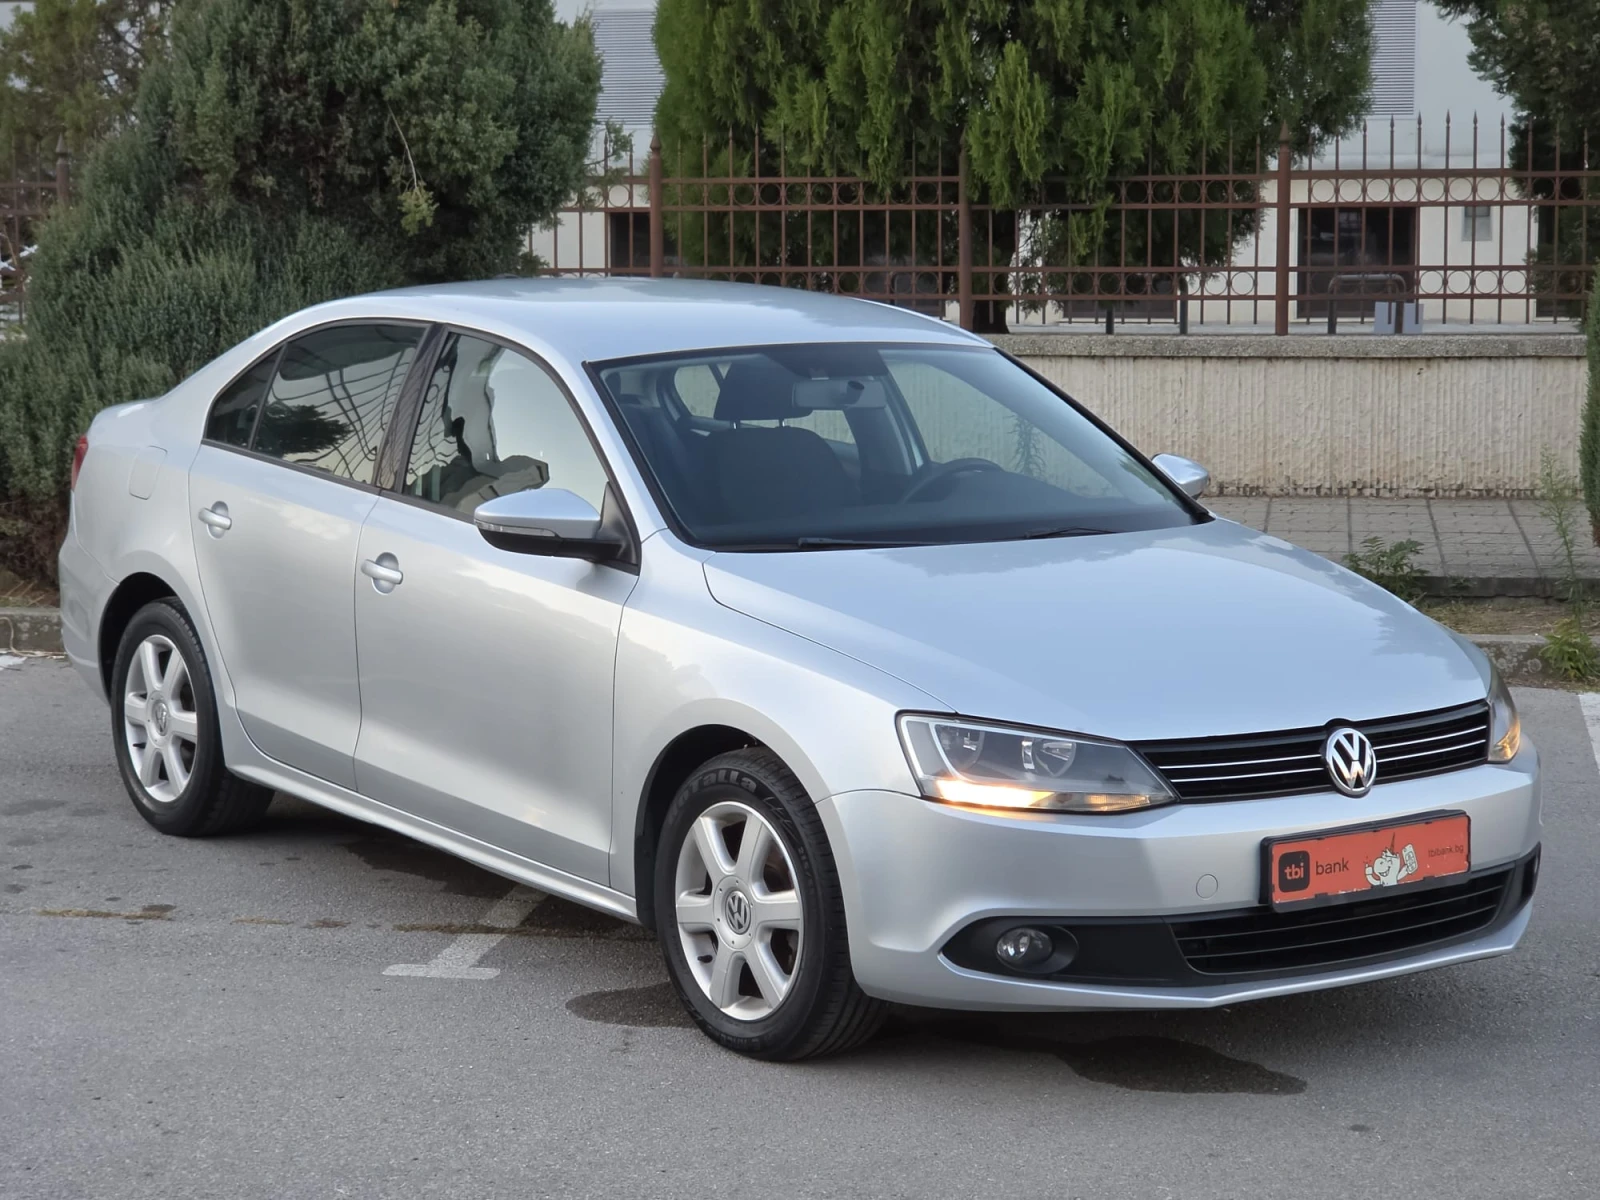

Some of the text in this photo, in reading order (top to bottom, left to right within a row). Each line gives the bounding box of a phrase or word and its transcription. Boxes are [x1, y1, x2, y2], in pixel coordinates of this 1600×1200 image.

[1327, 728, 1376, 794] VW
[1284, 857, 1350, 880] tbi bank
[725, 890, 751, 935] VW
